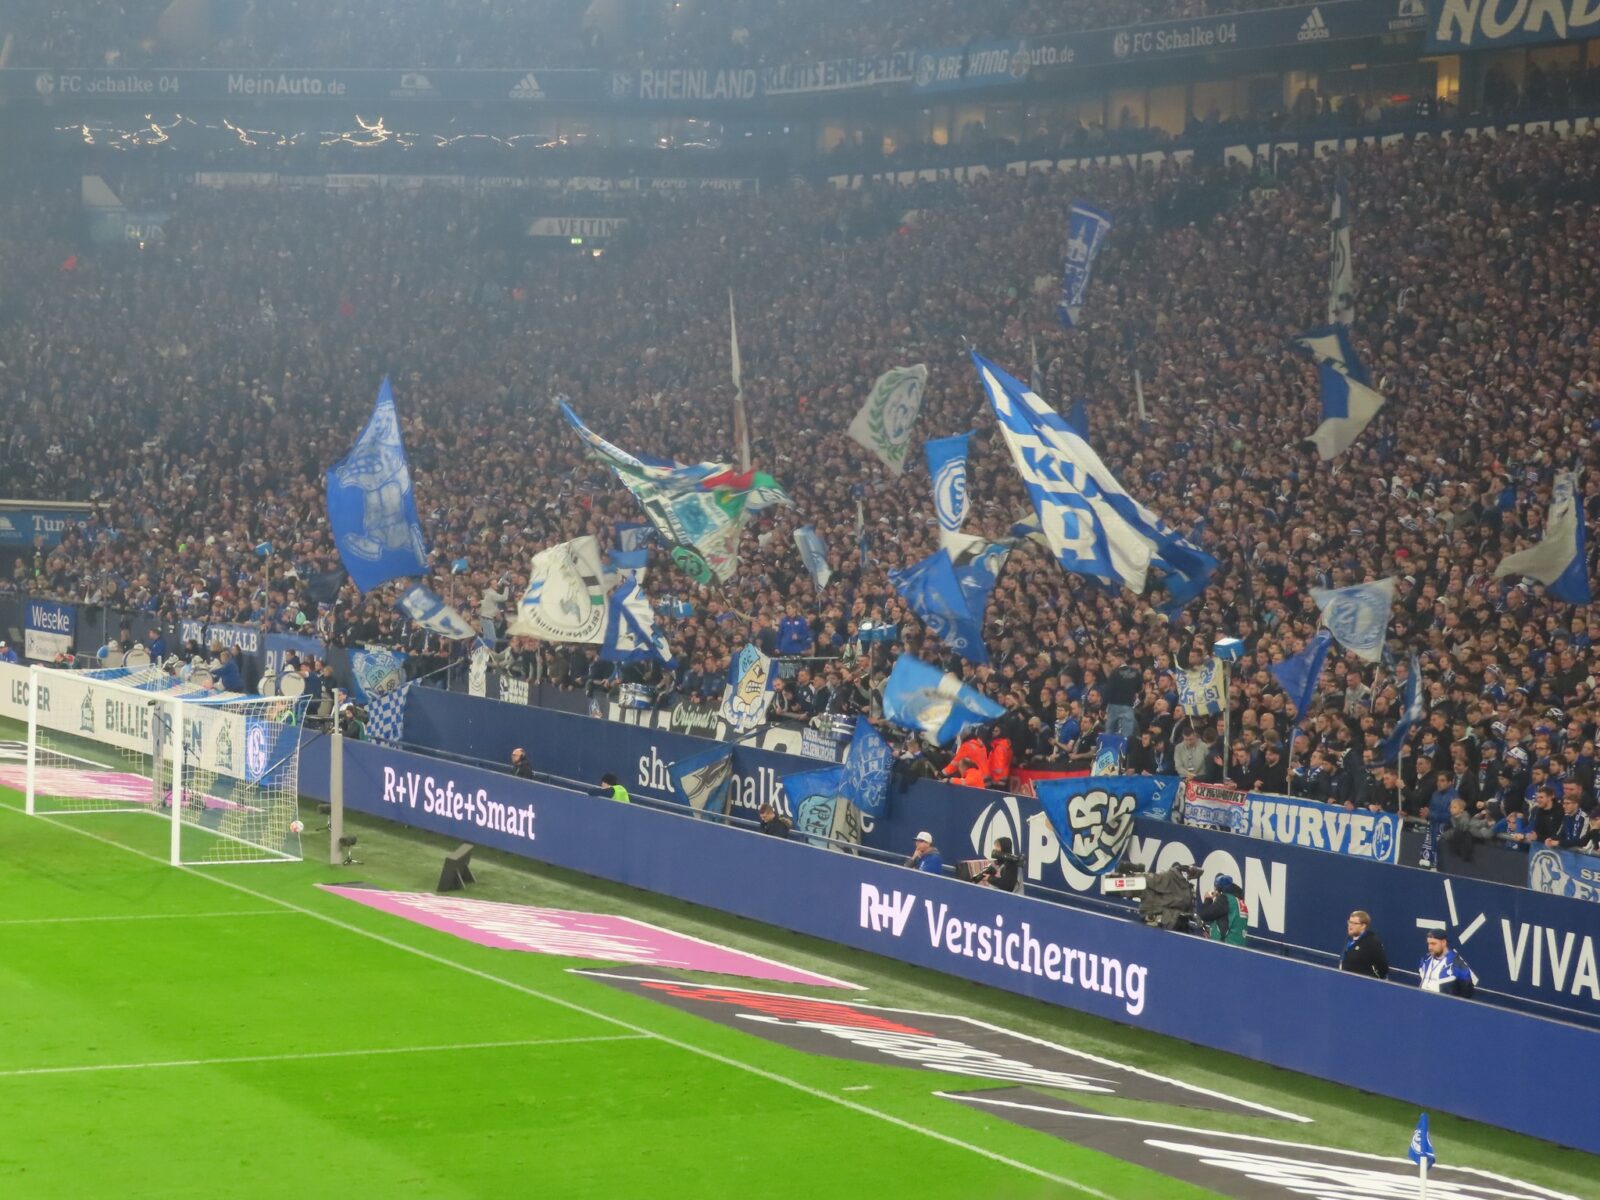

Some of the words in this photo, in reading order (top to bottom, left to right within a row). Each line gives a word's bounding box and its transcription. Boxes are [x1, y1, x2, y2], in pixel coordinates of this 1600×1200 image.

[1133, 32, 1151, 51] FC
[1156, 26, 1213, 50] Schalke
[1217, 23, 1237, 43] 04
[59, 76, 81, 92] FC
[159, 76, 180, 93] 04
[227, 74, 347, 96] MeinAuto.de
[639, 69, 757, 100] RHEINLAND
[32, 606, 70, 631] Weseke
[11, 679, 51, 712] LECER
[105, 698, 148, 740] BILLIE
[671, 702, 712, 735] Original
[383, 766, 421, 809] R+V
[423, 776, 536, 840] Safe+Smart
[1249, 800, 1376, 857] KURVE
[924, 899, 1148, 1016] Versicherung
[1501, 918, 1600, 1002] VIVA
